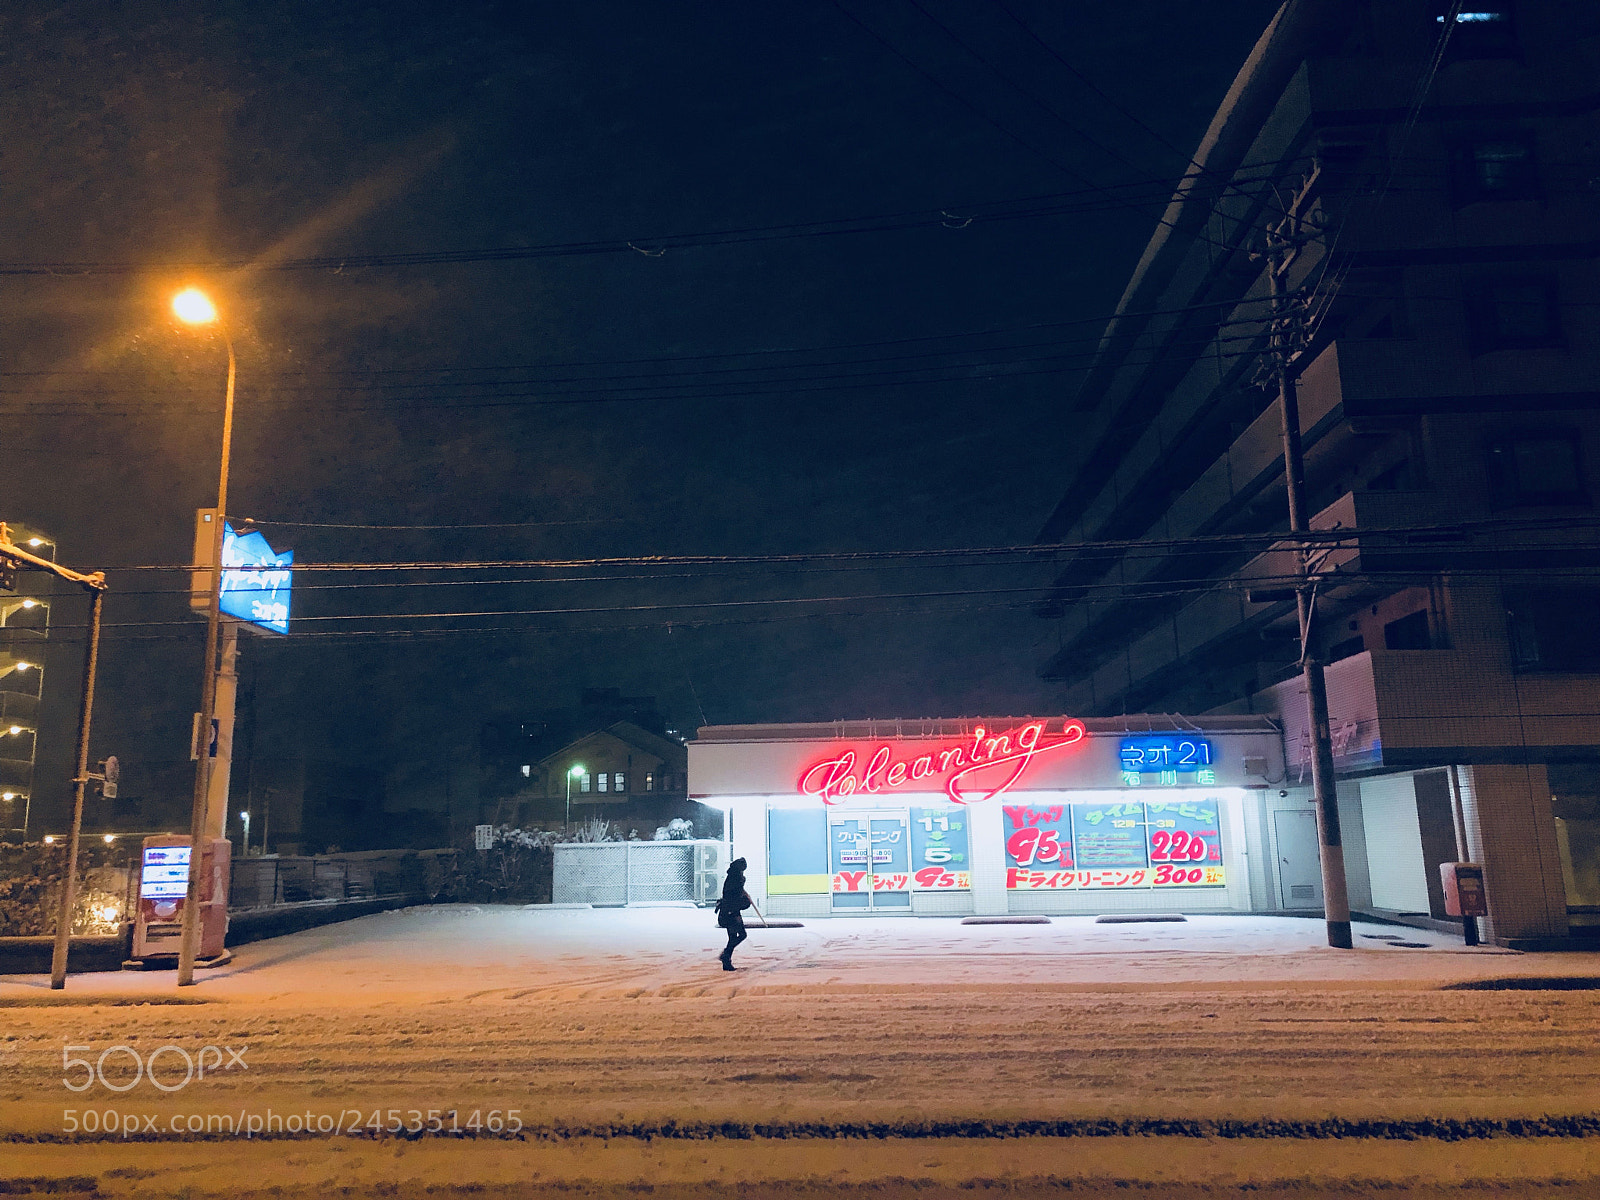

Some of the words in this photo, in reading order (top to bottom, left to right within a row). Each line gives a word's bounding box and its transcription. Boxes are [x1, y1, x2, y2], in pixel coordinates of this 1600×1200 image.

[800, 718, 1086, 804] Cleaning
[1122, 769, 1216, 787] 石川店
[1150, 830, 1208, 862] 220
[1006, 868, 1146, 888] ドライクリーニング
[1153, 865, 1203, 885] 300
